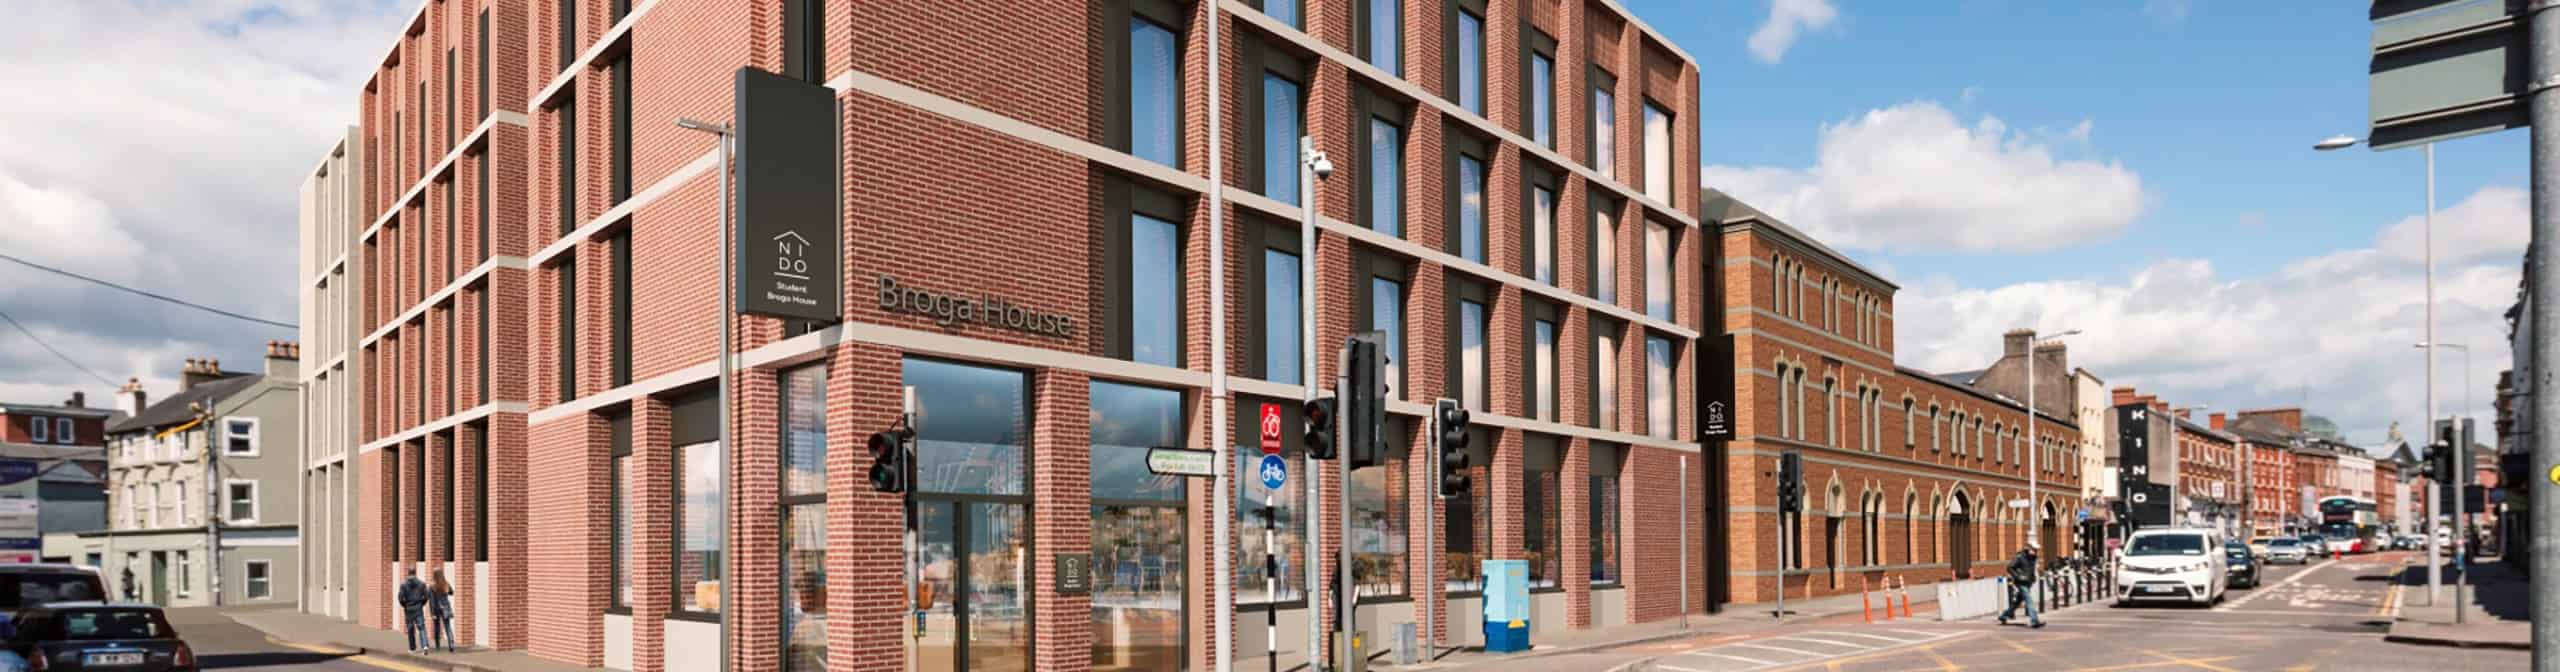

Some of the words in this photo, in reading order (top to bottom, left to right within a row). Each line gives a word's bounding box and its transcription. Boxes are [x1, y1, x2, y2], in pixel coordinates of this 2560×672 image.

[792, 295, 817, 306] House
[879, 272, 973, 325] Broga
[984, 291, 1073, 336] House
